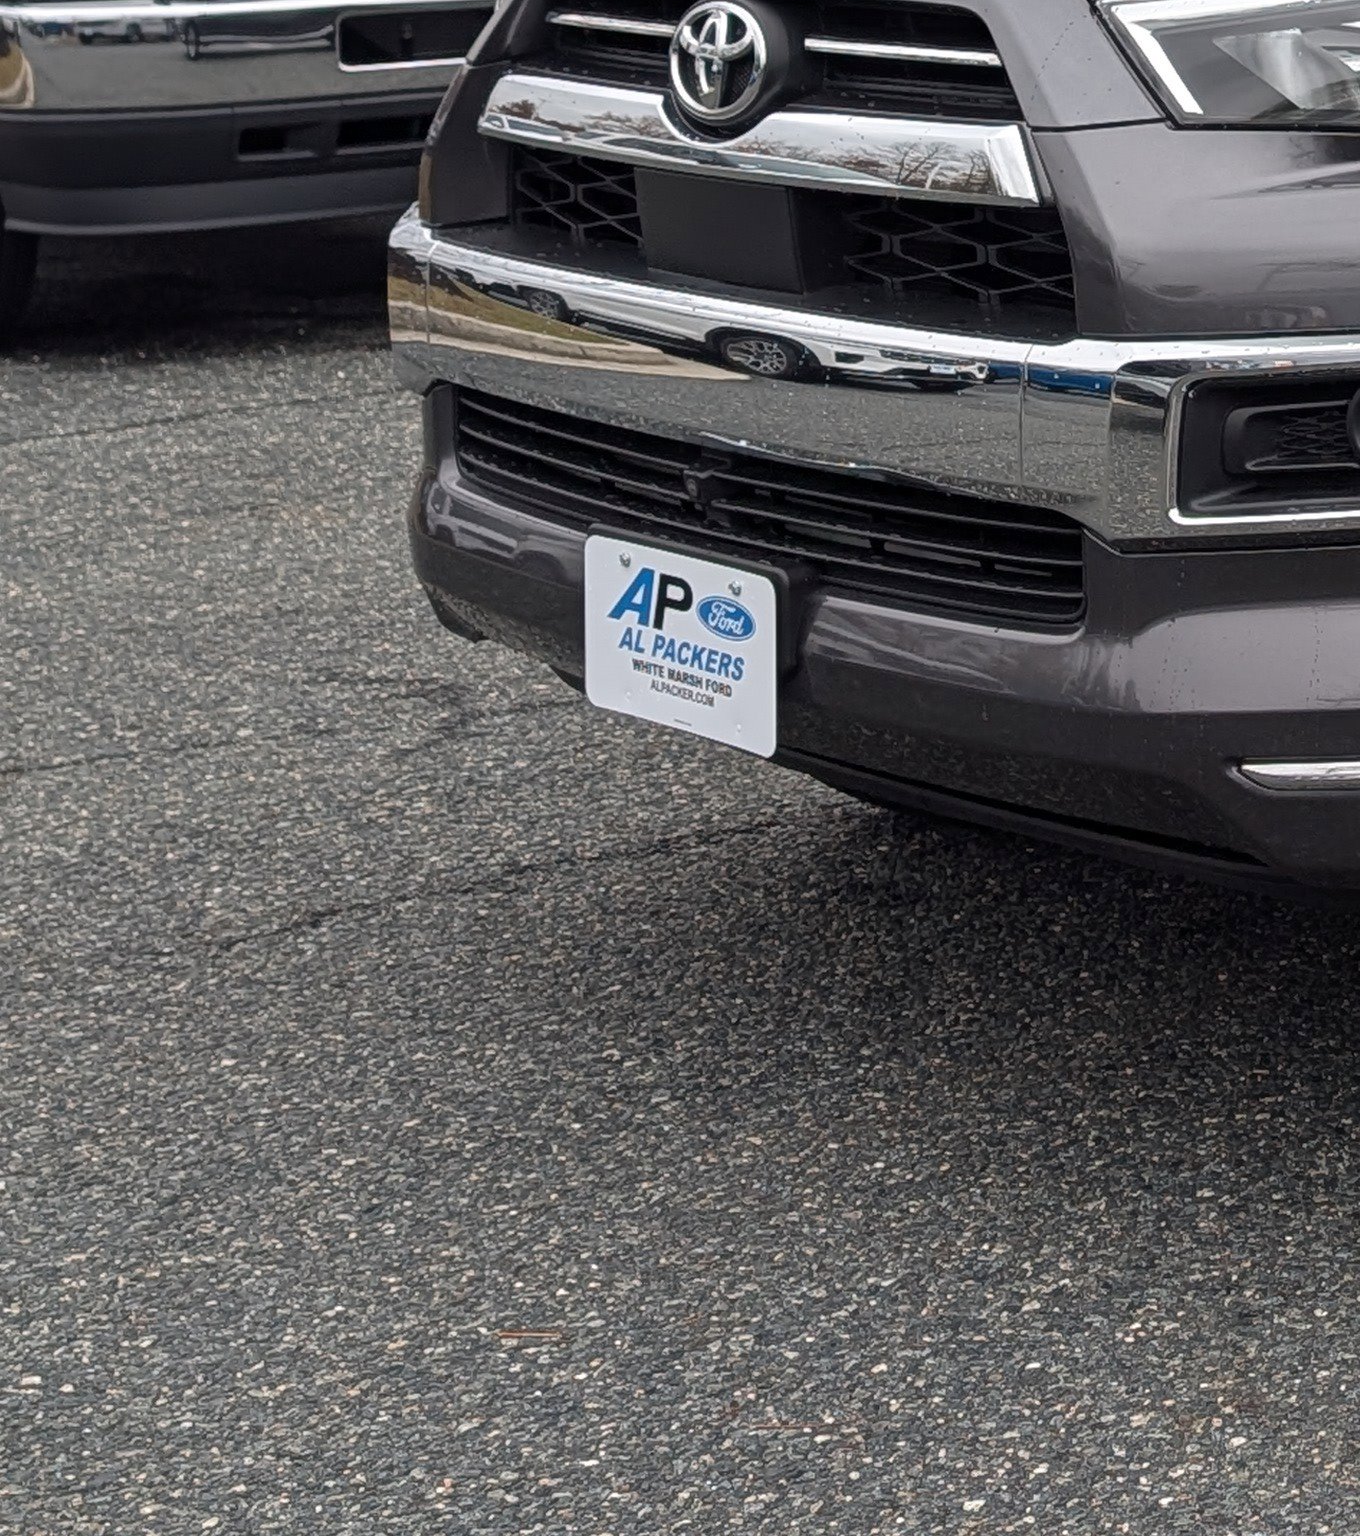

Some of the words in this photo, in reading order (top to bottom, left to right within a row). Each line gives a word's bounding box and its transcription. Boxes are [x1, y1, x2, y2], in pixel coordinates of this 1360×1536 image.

[608, 567, 693, 631] AP
[618, 626, 646, 654] AL
[651, 633, 745, 682] PACKERS
[632, 657, 665, 678] WHITE
[667, 667, 703, 690] MARSH
[705, 678, 733, 698] FORD
